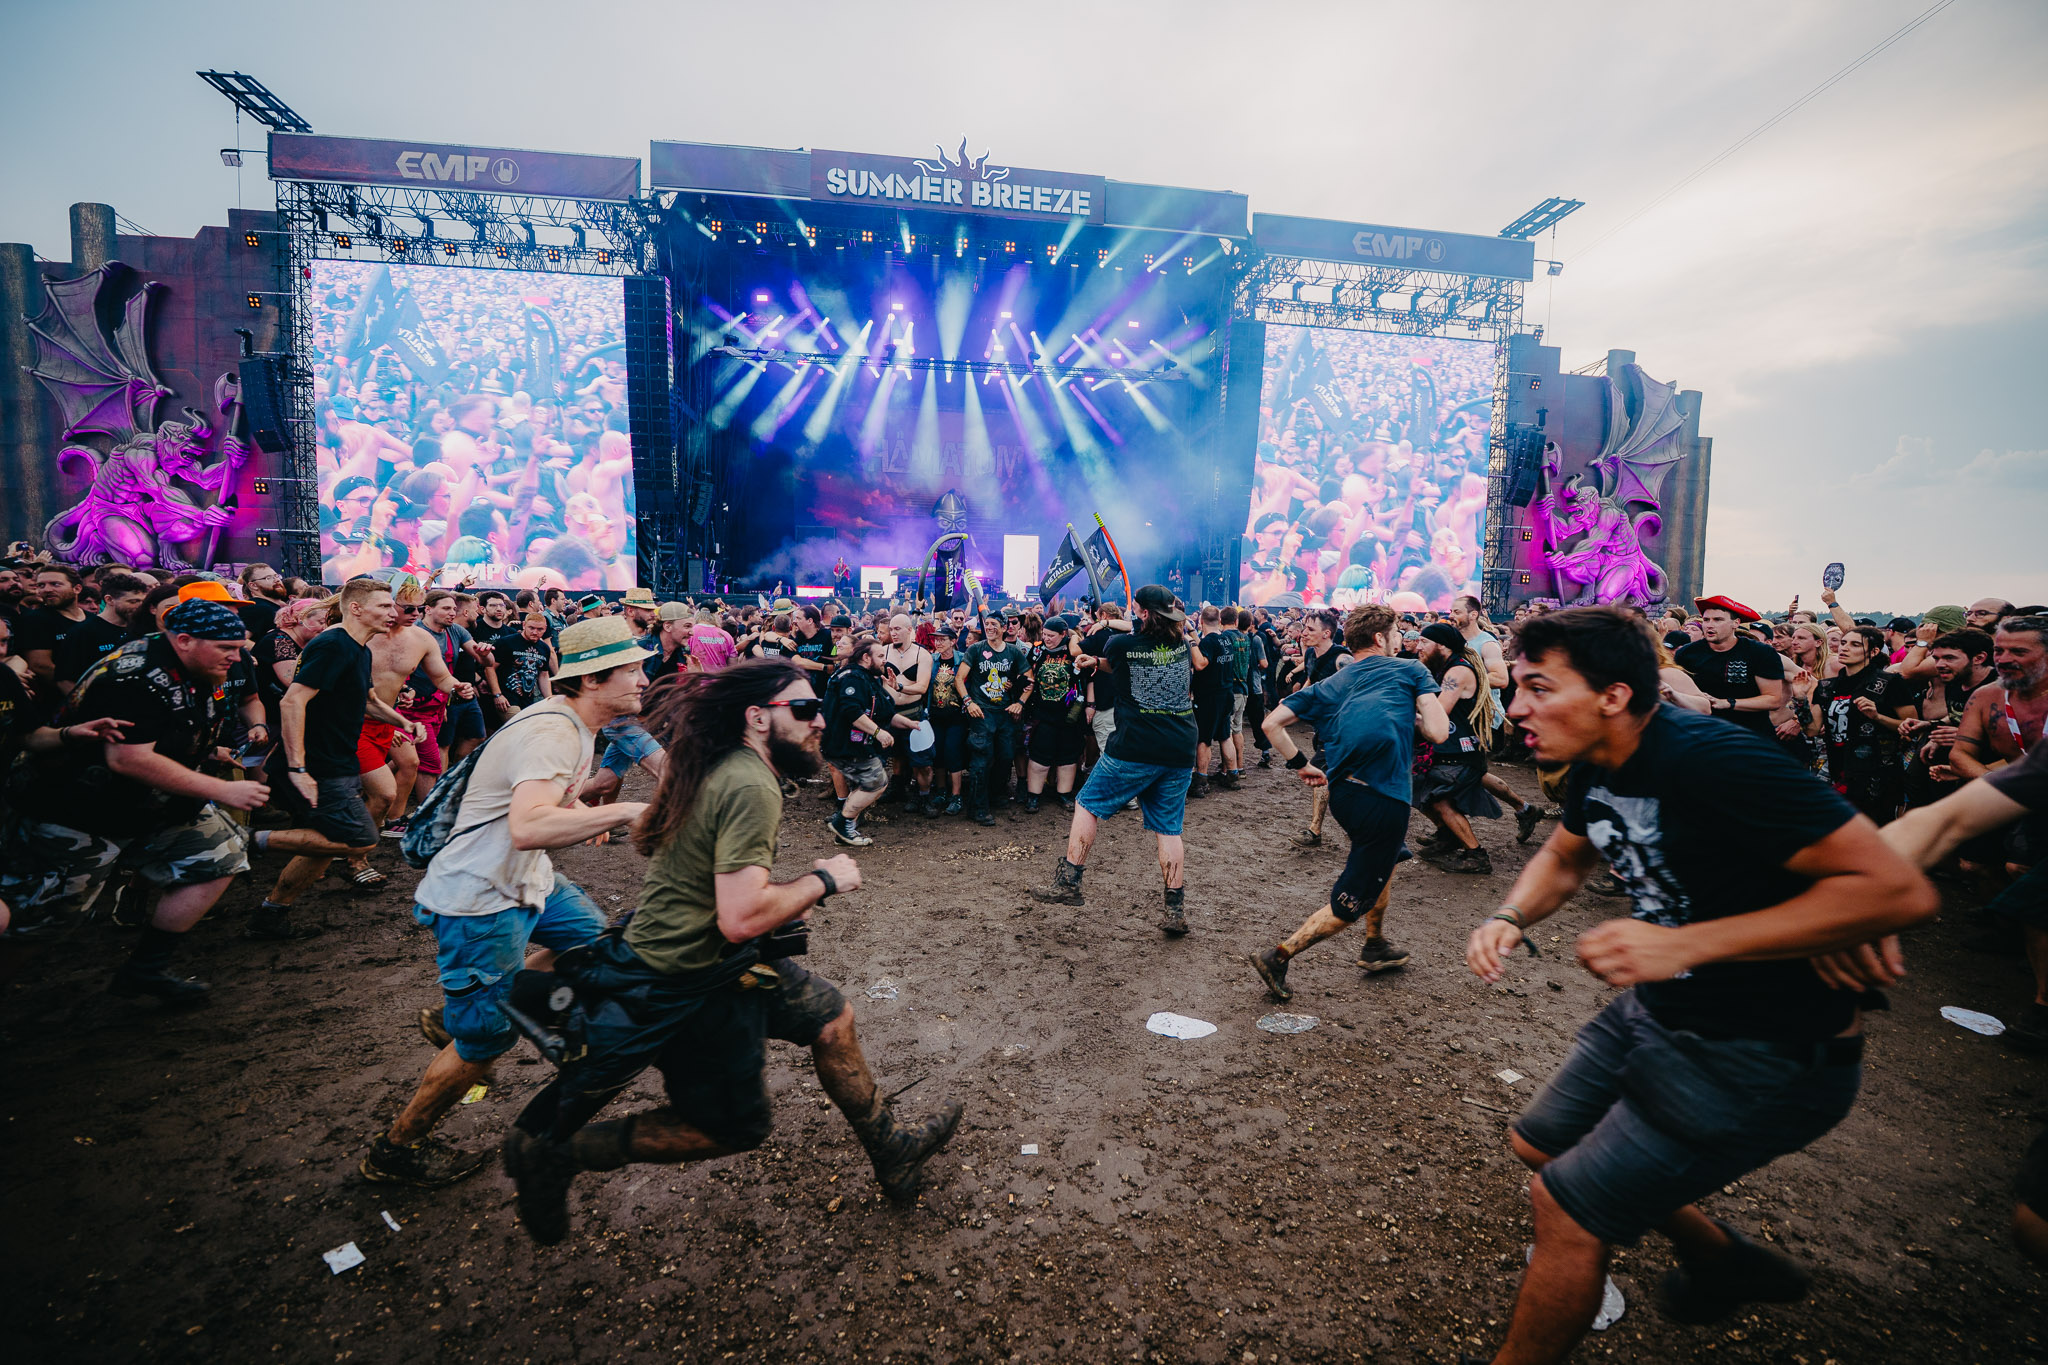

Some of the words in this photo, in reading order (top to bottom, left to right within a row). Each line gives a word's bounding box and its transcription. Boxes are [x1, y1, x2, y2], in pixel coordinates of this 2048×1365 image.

[396, 151, 490, 182] EMP
[826, 167, 963, 206] SUMMER
[971, 180, 1091, 216] BREEZE
[1352, 231, 1424, 259] EMP
[1045, 560, 1075, 589] METALITY
[1126, 651, 1164, 659] SUMMER
